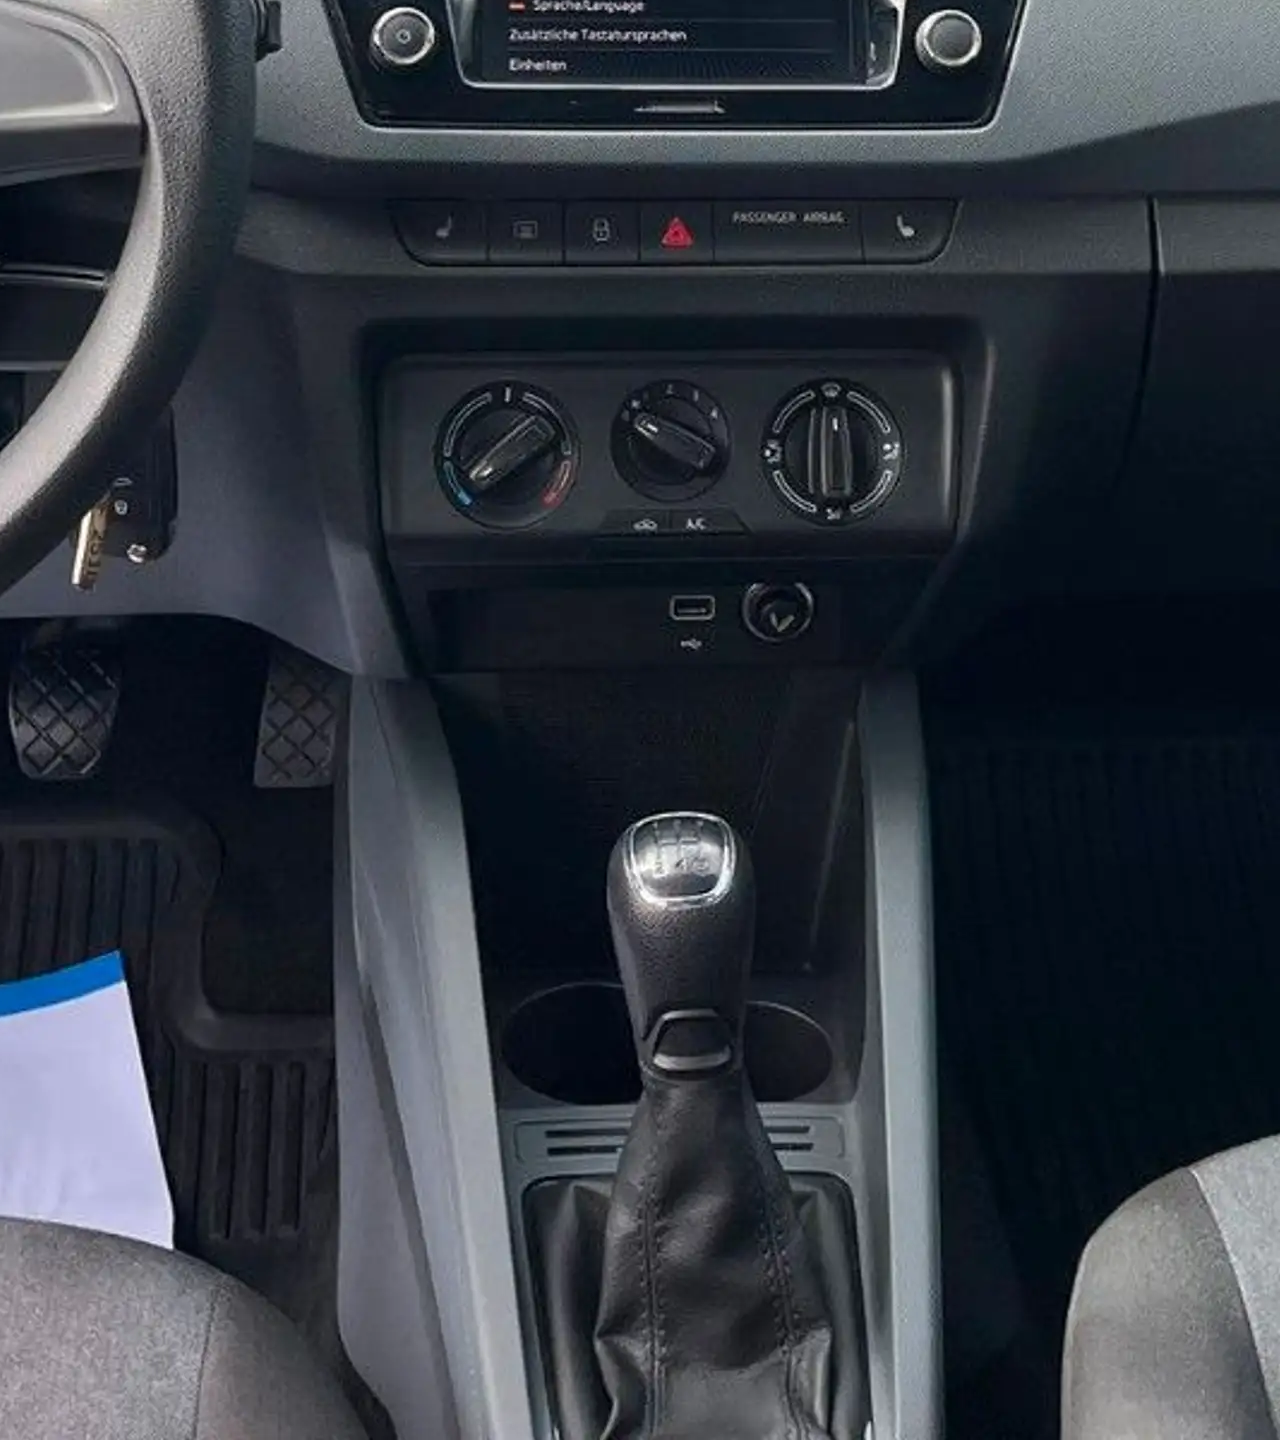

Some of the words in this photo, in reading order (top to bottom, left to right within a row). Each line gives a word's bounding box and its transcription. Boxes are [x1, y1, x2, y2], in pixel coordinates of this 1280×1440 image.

[508, 28, 579, 42] Zusätzliche
[580, 28, 688, 45] Tastatursprachen
[508, 59, 568, 72] Einheiten
[732, 210, 797, 224] PASSENGER
[803, 210, 845, 224] AIRBAG
[685, 517, 707, 531] A/C
